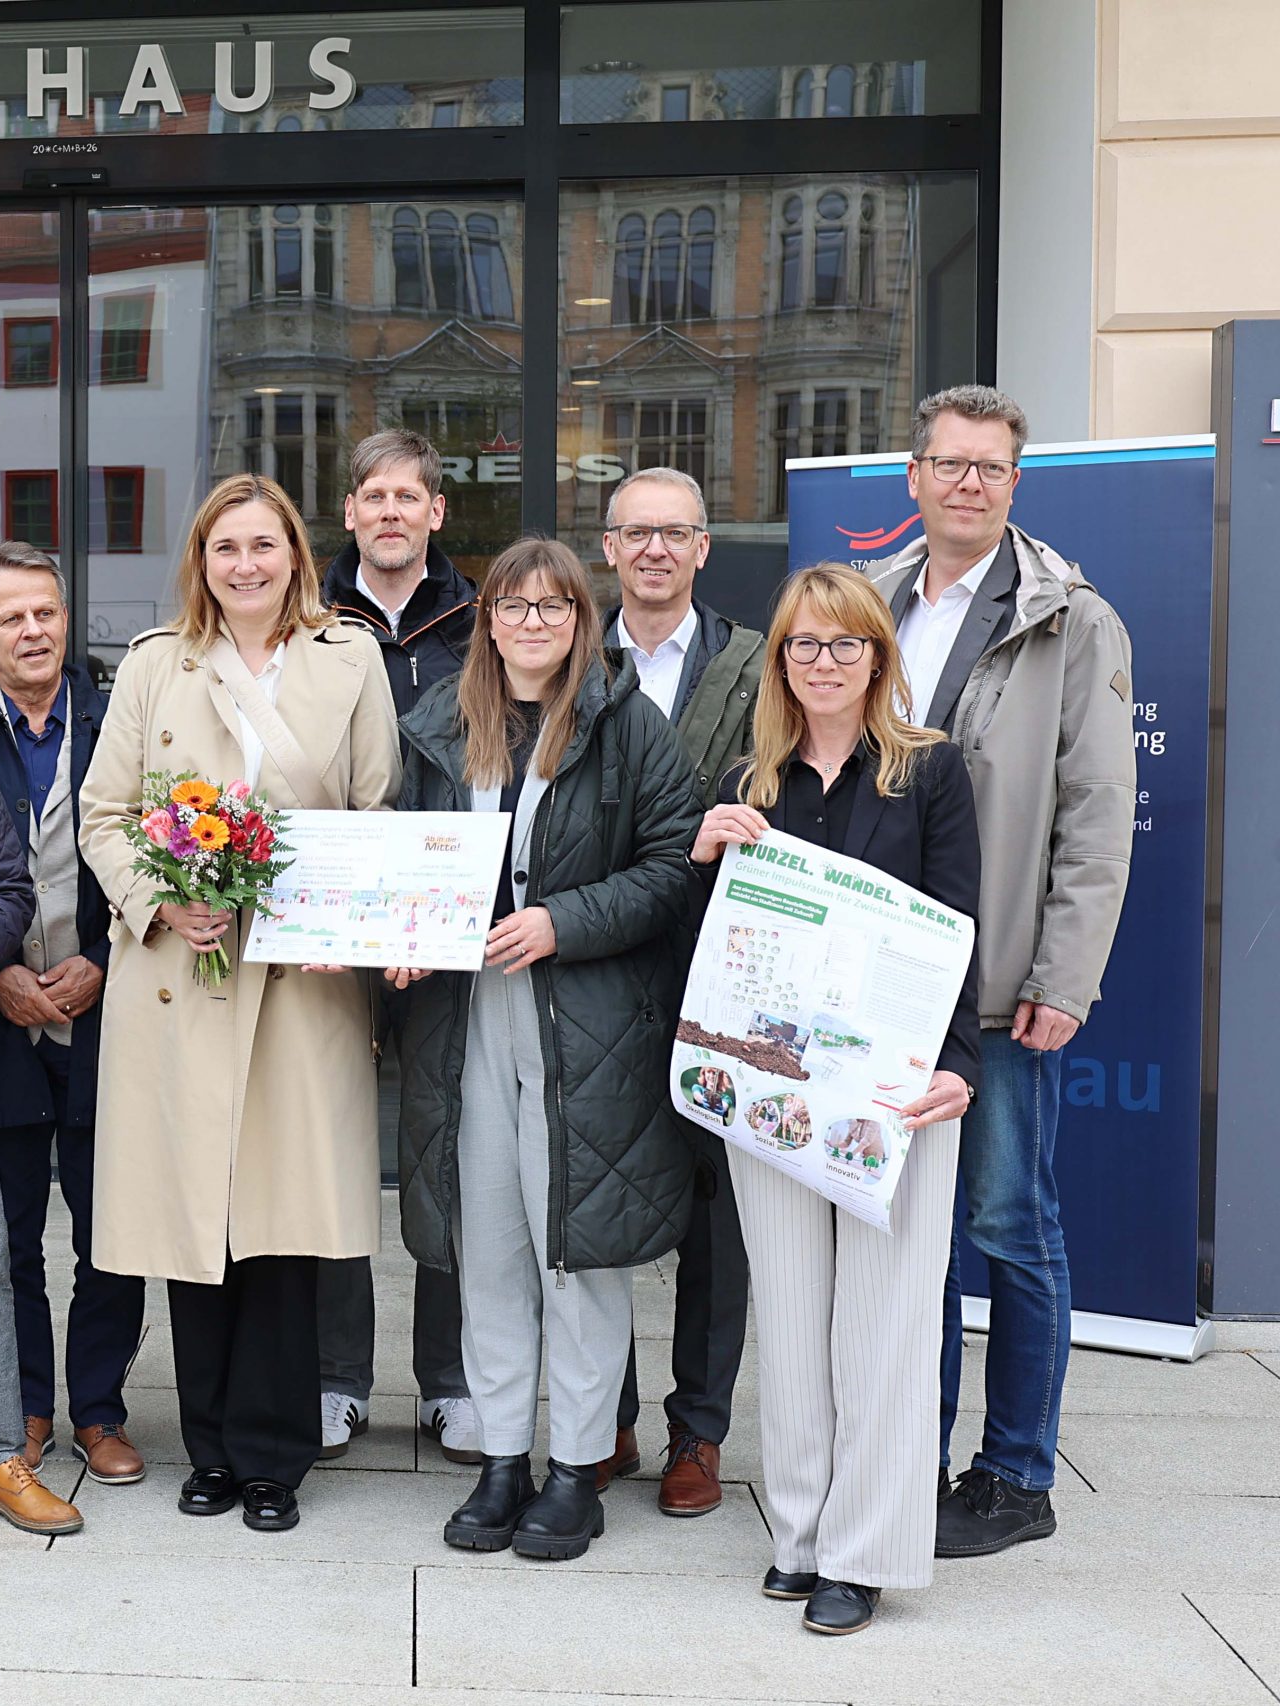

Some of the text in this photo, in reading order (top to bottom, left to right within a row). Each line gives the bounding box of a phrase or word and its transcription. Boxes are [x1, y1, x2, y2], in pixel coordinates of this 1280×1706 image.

[1135, 790, 1150, 804] e
[424, 842, 461, 852] Mitte!
[739, 842, 962, 933] WURZEL. WANDEL. WERK.
[735, 860, 960, 945] Grüner Impulsraum für Zwickaus Innenstadt
[685, 1102, 722, 1125] Ökologisch
[754, 1133, 776, 1148] Sozial
[825, 1161, 861, 1182] Innovativ
